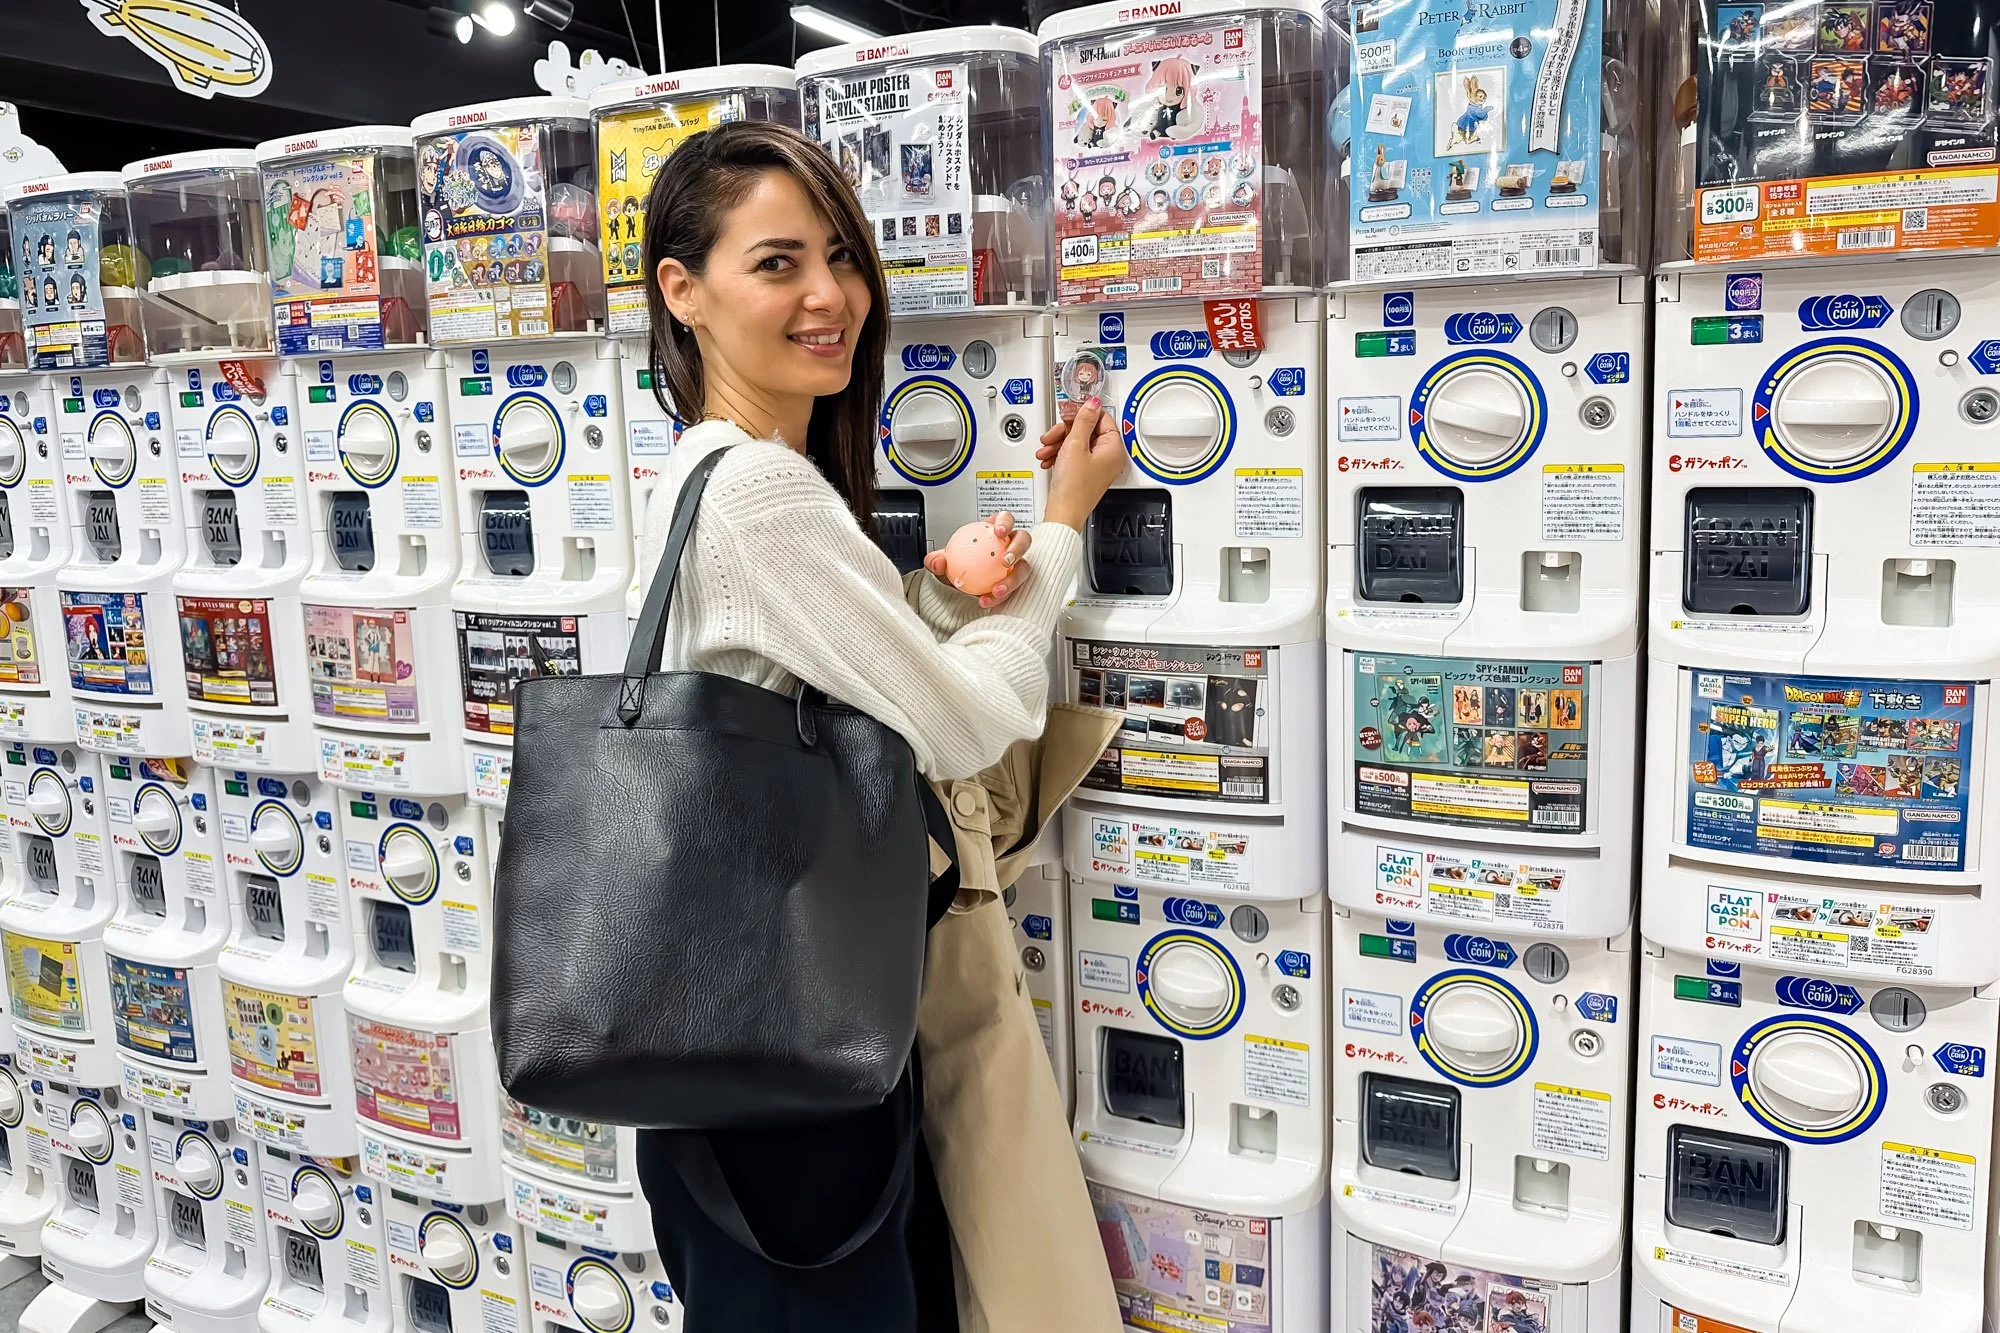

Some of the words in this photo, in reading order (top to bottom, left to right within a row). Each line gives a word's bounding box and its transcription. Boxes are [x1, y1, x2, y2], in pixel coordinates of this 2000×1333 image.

[1132, 2, 1181, 18] BANDAI
[1419, 12, 1460, 26] PETER
[1479, 3, 1526, 18] RABBIT
[1225, 31, 1242, 40] BAN
[1225, 39, 1239, 48] DAI
[1222, 51, 1253, 61] ガシャポン
[1360, 44, 1391, 58] 500円
[1438, 48, 1465, 58] Book
[1363, 57, 1378, 66] TAX
[937, 71, 952, 81] BAN
[869, 75, 910, 95] POSTER
[937, 79, 950, 87] DAI
[864, 95, 895, 112] STAND
[898, 94, 909, 108] 01
[456, 111, 487, 125] BANDAI
[291, 139, 318, 152] BANDAI
[1932, 153, 1961, 162] BANDAI
[1961, 151, 1991, 160] NAMCO
[148, 160, 172, 173] BANDAI
[28, 183, 49, 193] BANDAI
[1834, 301, 1857, 309] コイン
[1239, 302, 1253, 330] SOLD
[1832, 308, 1859, 320] COIN
[1866, 308, 1881, 318] IN
[1212, 303, 1244, 349] うりきれ
[1473, 325, 1495, 335] COIN
[1502, 326, 1513, 334] IN
[1242, 331, 1257, 348] OUT
[1174, 341, 1193, 351] COIN
[1197, 342, 1207, 350] IN
[921, 354, 937, 363] COIN
[1674, 410, 1730, 418] ハンドルをゆっくり
[1674, 418, 1738, 428] 1回転させてください。
[1351, 457, 1399, 470] ガシャポン
[1684, 456, 1741, 470] ガシャポン
[206, 507, 233, 525] BAN
[335, 510, 366, 529] BAN
[335, 531, 360, 547] DAI
[486, 532, 517, 550] DAI
[1375, 544, 1429, 570] DAI
[1707, 551, 1769, 579] DAI
[1092, 647, 1159, 658] シン・ウルトラマン
[1245, 652, 1261, 660] BAN
[1093, 656, 1203, 672] ビッグサイズ色紙コレクション
[1475, 663, 1529, 675] SPY×FAMILY
[1564, 668, 1582, 676] BAN
[1444, 672, 1560, 685] ビッグサイズ色紙コレクション
[1564, 675, 1578, 683] DAI
[1784, 685, 1824, 704] DRAGON
[1945, 689, 1967, 697] BAN
[1869, 693, 1923, 710] 下敷き
[1945, 696, 1961, 704] DAI
[1716, 712, 1748, 726] SUPER
[1750, 716, 1776, 730] HERO
[478, 759, 492, 767] FLAT
[1694, 763, 1713, 771] ビッグ
[1099, 823, 1122, 835] FLAT
[1094, 833, 1128, 846] GASHA
[1100, 843, 1122, 854] PON
[1386, 853, 1414, 866] FLAT
[1100, 862, 1130, 875] ガシャポン
[1379, 863, 1420, 878] GASHA
[1386, 875, 1413, 887] PON
[251, 888, 277, 909] BAN
[1385, 896, 1421, 909] ガシャポン
[1719, 893, 1752, 907] FLAT
[1185, 909, 1203, 920] COIN
[1710, 904, 1760, 920] GASHA
[1718, 917, 1750, 929] PON
[1470, 947, 1492, 958] COIN
[1717, 940, 1760, 954] ガシャポン
[1497, 952, 1508, 961] IN
[1896, 966, 1933, 976] FG28390
[1809, 985, 1831, 993] コイン
[1807, 991, 1833, 1003] COIN
[1839, 996, 1852, 1006] IN
[1092, 1002, 1131, 1017] ガシャポン
[1357, 1047, 1404, 1063] ガシャポン
[1657, 1054, 1710, 1067] ハンドルをゆっくり
[1950, 1051, 1966, 1060] COIN
[1667, 1099, 1724, 1116] ガシャポン
[1688, 1150, 1764, 1190] BAN
[1192, 1210, 1227, 1228] Disney
[1226, 1219, 1246, 1229] 100
[290, 1243, 318, 1271] BAN
